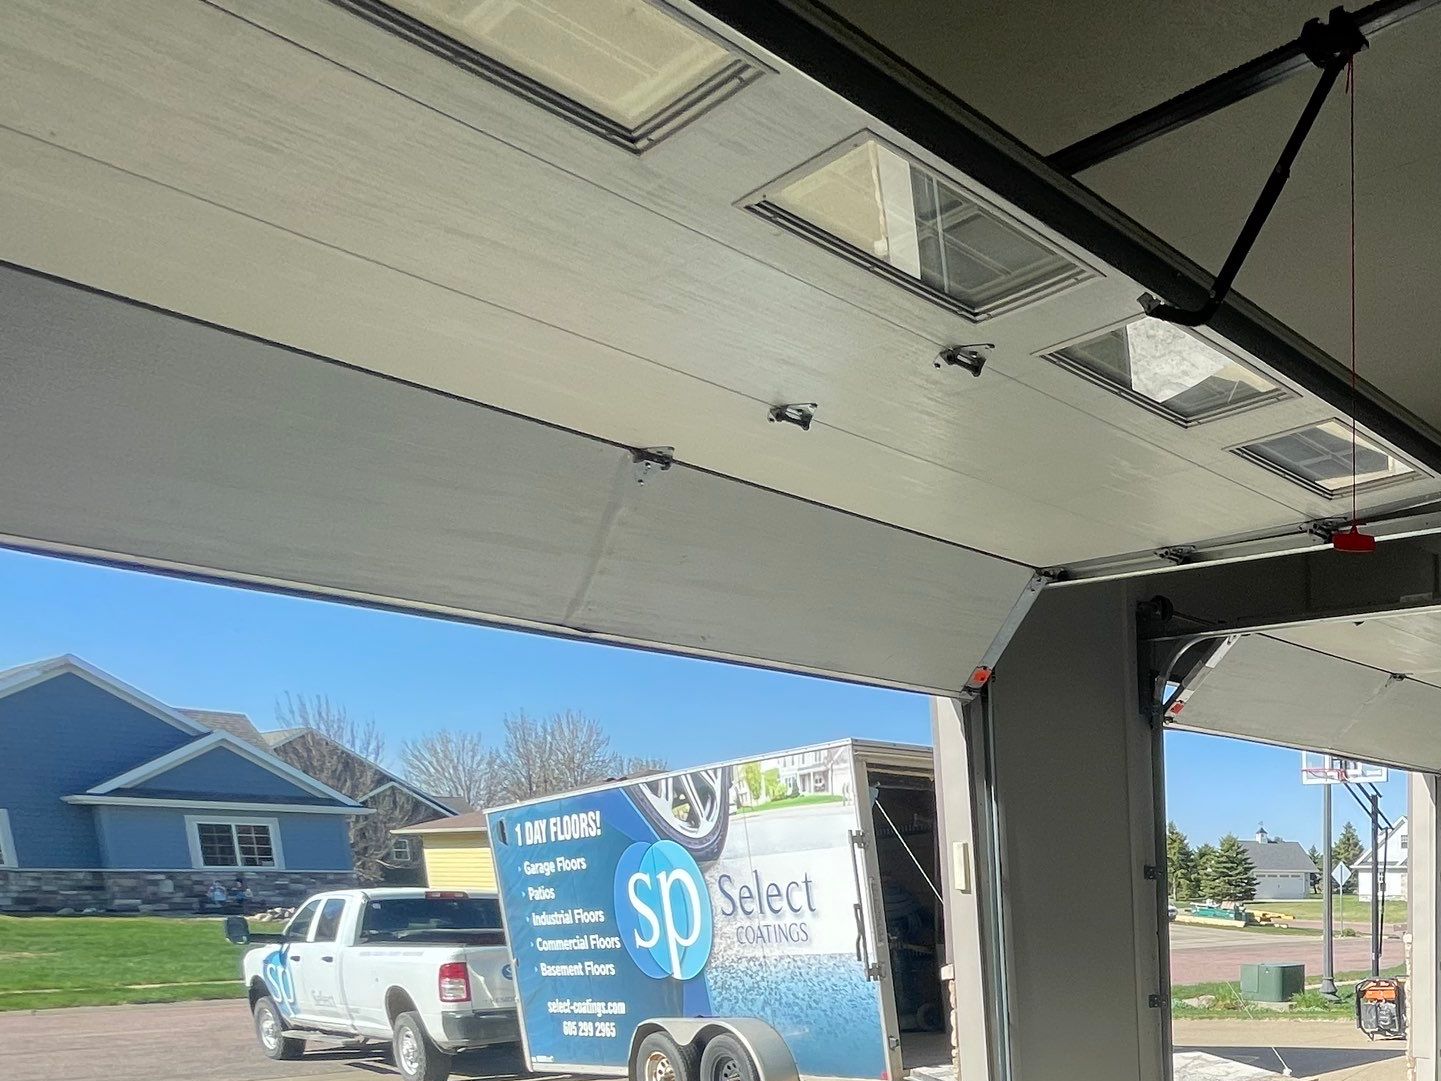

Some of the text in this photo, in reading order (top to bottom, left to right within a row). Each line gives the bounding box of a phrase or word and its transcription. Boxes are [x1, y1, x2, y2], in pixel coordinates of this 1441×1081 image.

[515, 810, 602, 846] 1 DAY FLOORS!
[523, 856, 587, 876] Garage Floors
[527, 885, 556, 901] Patios
[718, 869, 816, 917] Select
[532, 908, 605, 927] Industrial Floors
[628, 868, 702, 980] sp
[536, 934, 621, 951] Commercial Floors
[736, 922, 810, 945] COATINGS
[540, 961, 616, 977] Basement Floors
[547, 998, 626, 1017] select-coatings.com
[578, 1021, 594, 1037] 299
[595, 1021, 617, 1038] 2965
